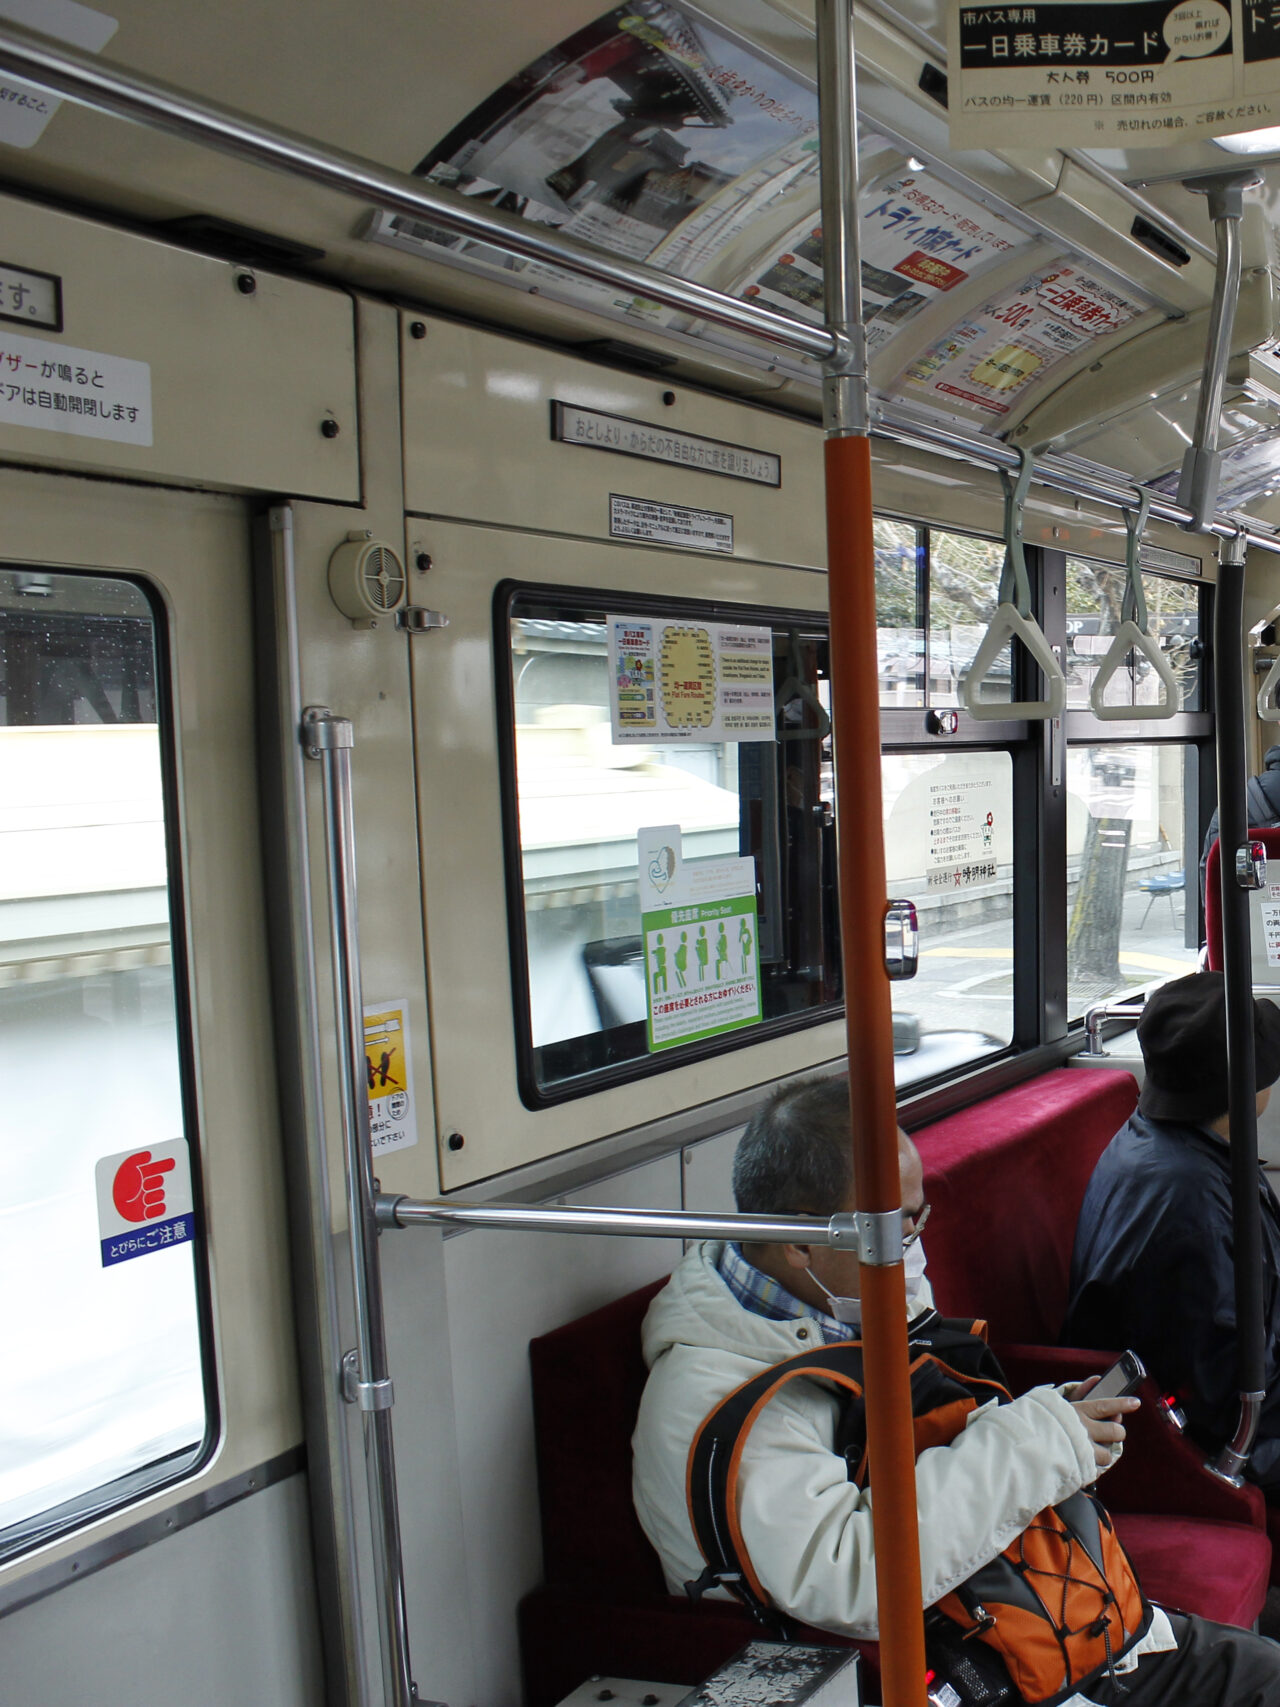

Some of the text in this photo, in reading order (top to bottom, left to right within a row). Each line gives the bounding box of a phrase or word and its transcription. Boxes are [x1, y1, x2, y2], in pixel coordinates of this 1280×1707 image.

[963, 9, 1036, 25] 市バス専用
[964, 31, 1159, 58] 一日乗車券カード
[1047, 70, 1155, 84] 大人券 500円
[0, 282, 37, 315] す。
[0, 352, 104, 388] ザーが鳴ると
[0, 383, 139, 423] アは自動開閉します
[720, 906, 732, 914] Seat
[368, 1120, 391, 1133] 部分に
[110, 1221, 187, 1258] とびらにご注意
